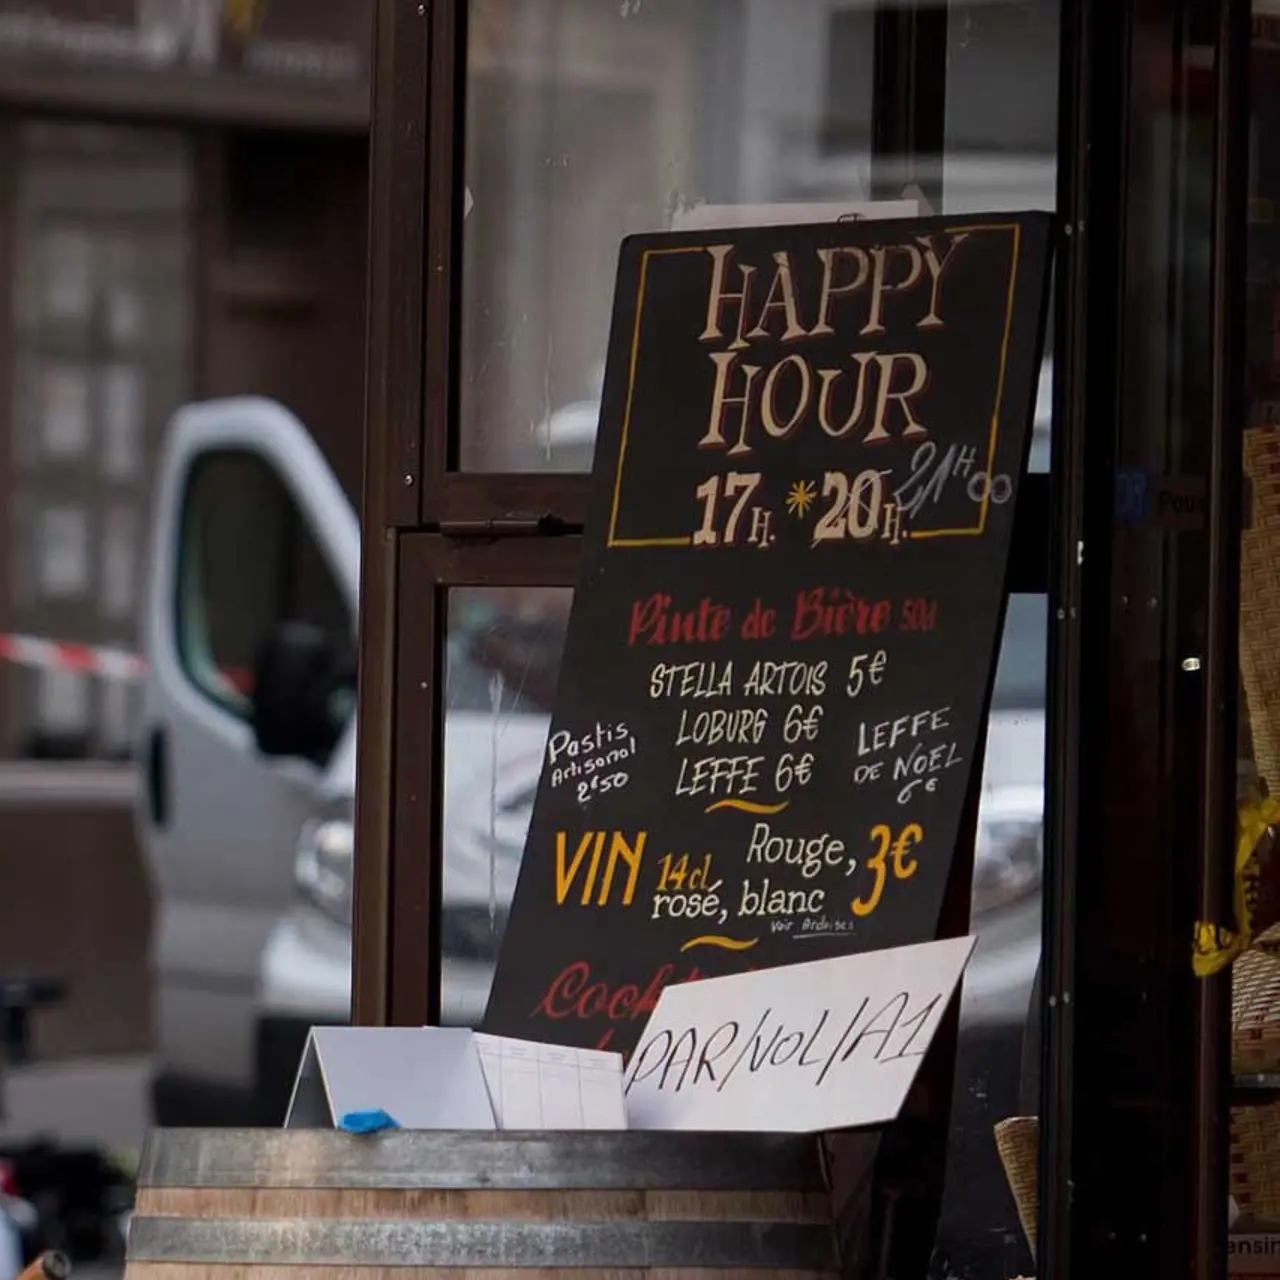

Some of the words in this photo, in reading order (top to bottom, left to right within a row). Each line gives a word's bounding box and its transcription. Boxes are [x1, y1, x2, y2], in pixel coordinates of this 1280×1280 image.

[698, 232, 970, 350] HAPPY
[697, 350, 928, 456] HOUR
[628, 593, 732, 647] Pinte
[741, 598, 777, 640] de
[791, 587, 892, 640] Bière
[650, 660, 733, 698] STELLA
[744, 660, 828, 697] ARTOIS
[847, 650, 887, 697] 5€
[549, 722, 628, 765] Pastis
[675, 708, 768, 746] LOBURG
[783, 704, 823, 744] 6€
[858, 706, 951, 757] LEFFE
[675, 756, 766, 796] LEFFE
[775, 753, 815, 793] 6€
[854, 761, 885, 784] DE
[893, 742, 963, 780] NOEL
[555, 830, 648, 906] VIN
[655, 853, 713, 893] 14cl
[746, 822, 857, 878] Rouge,
[850, 822, 924, 917] 3€
[651, 878, 727, 925] rosé,
[738, 878, 826, 917] blanc
